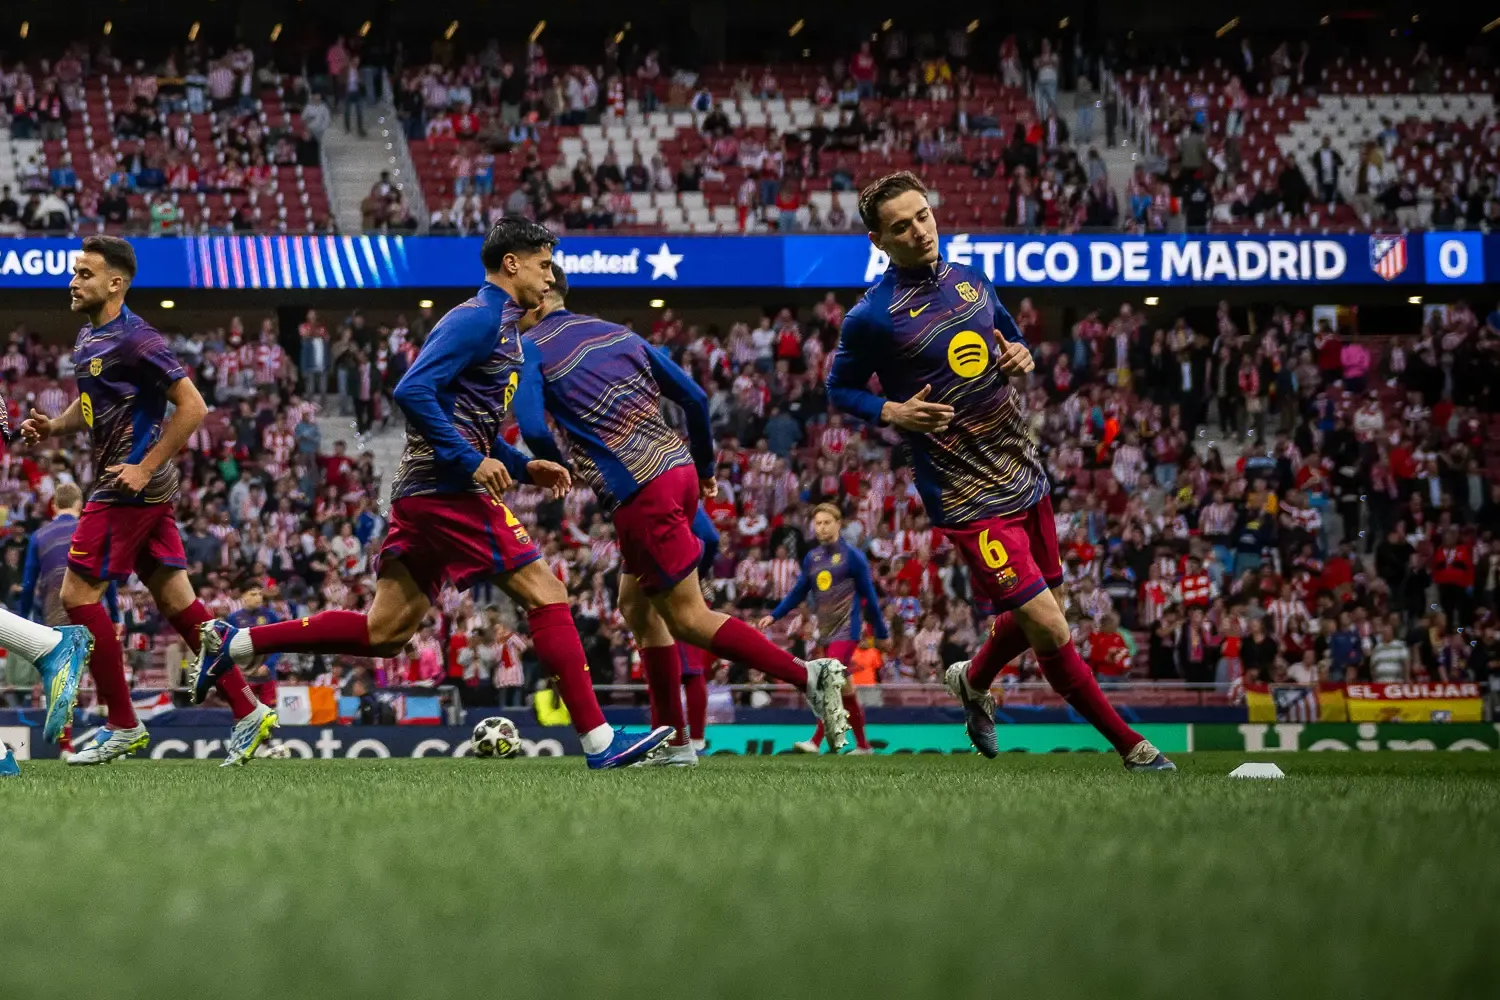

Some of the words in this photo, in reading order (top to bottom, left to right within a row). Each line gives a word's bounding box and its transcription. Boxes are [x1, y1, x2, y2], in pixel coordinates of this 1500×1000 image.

[864, 233, 1080, 283] AÉTICO
[1090, 241, 1151, 282] DE
[1160, 240, 1348, 282] MADRID
[1438, 238, 1469, 280] 0
[978, 528, 1009, 570] 6
[1347, 684, 1379, 699] EL
[1384, 683, 1480, 699] GUIJAR
